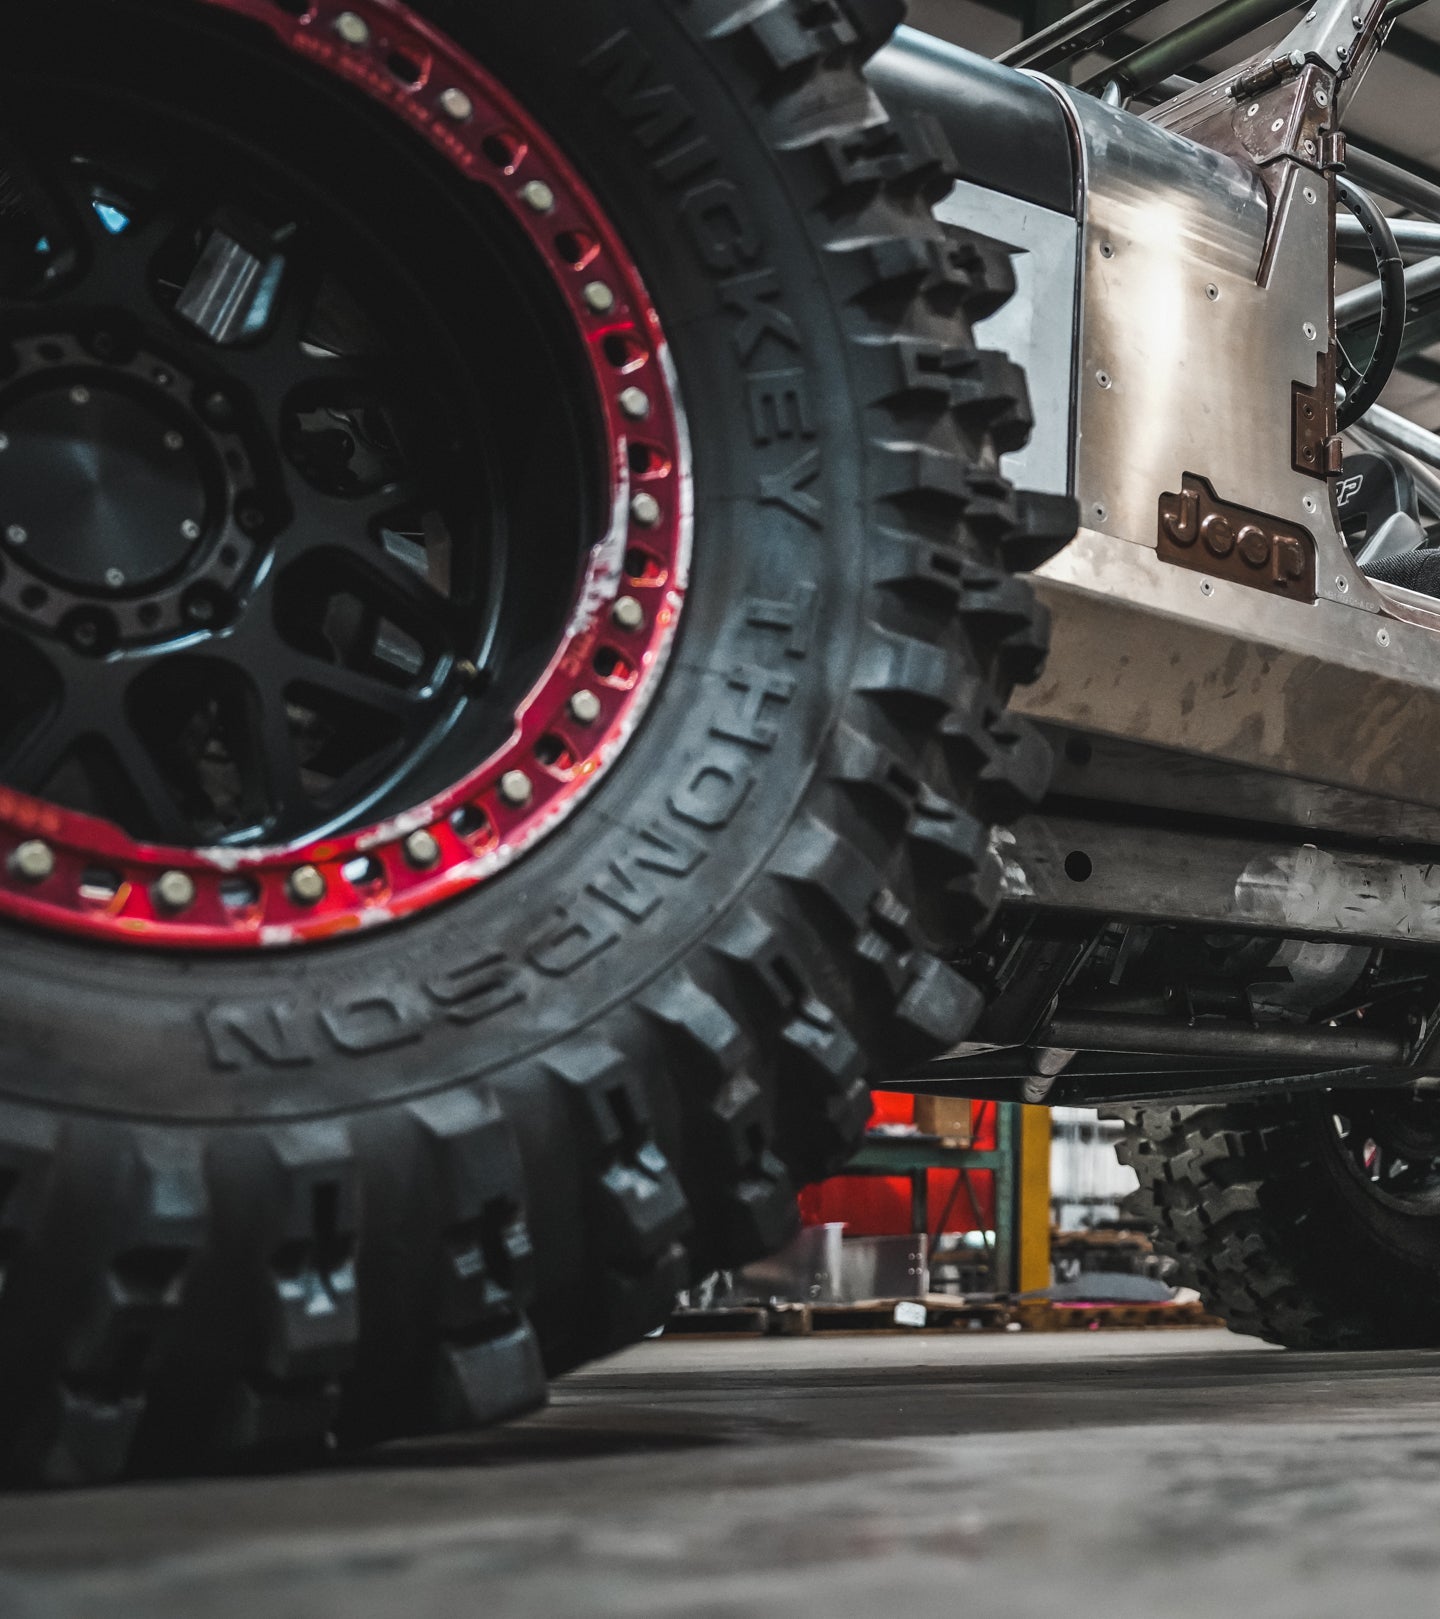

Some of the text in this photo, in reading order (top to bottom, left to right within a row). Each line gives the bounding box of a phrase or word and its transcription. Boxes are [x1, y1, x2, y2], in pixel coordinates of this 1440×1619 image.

[580, 27, 824, 532] MICKEY
[1163, 488, 1305, 588] Jeep
[203, 578, 816, 1070] THOMPSON
